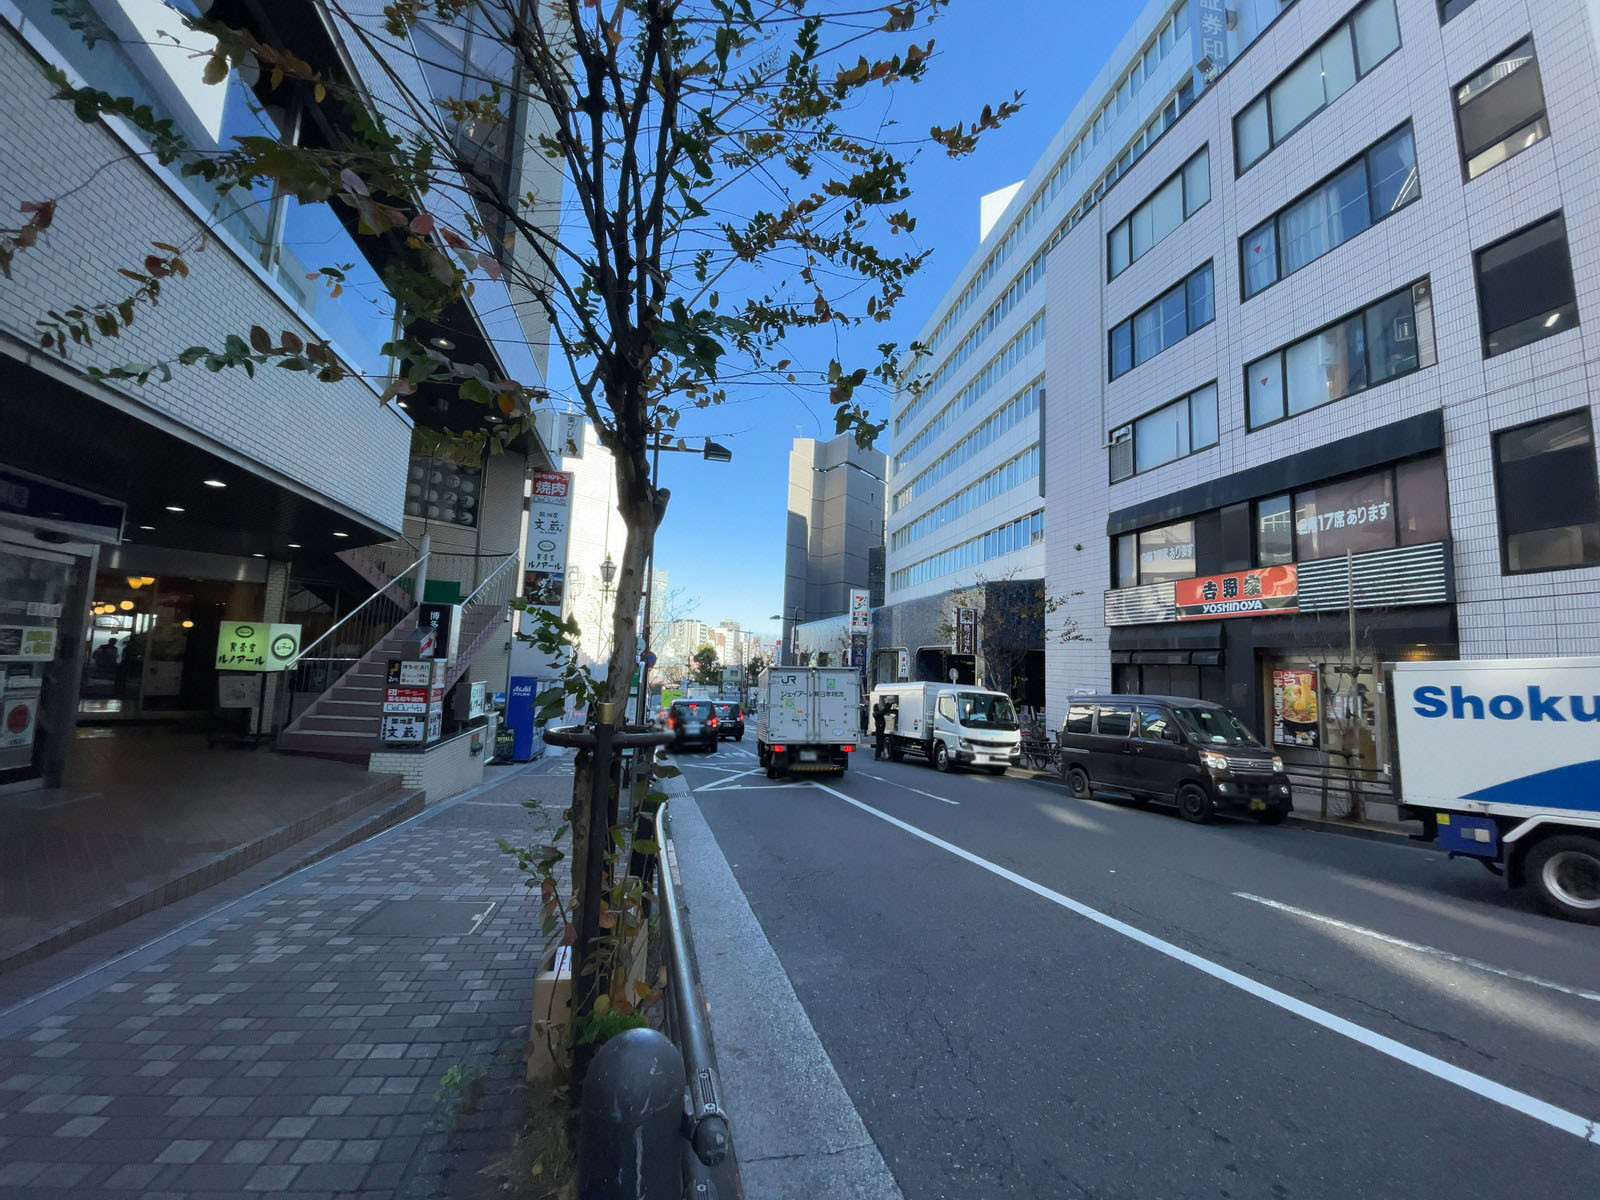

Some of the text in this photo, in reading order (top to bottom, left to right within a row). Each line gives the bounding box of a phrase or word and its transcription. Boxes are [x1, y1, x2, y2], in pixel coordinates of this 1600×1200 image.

[535, 481, 566, 495] 焼肉
[528, 561, 562, 570] ルノアール
[1202, 574, 1262, 601] 吉野家
[218, 654, 265, 666] ルノアール
[781, 675, 797, 685] JR
[512, 685, 532, 693] Asahi
[1413, 685, 1600, 723] Shoku
